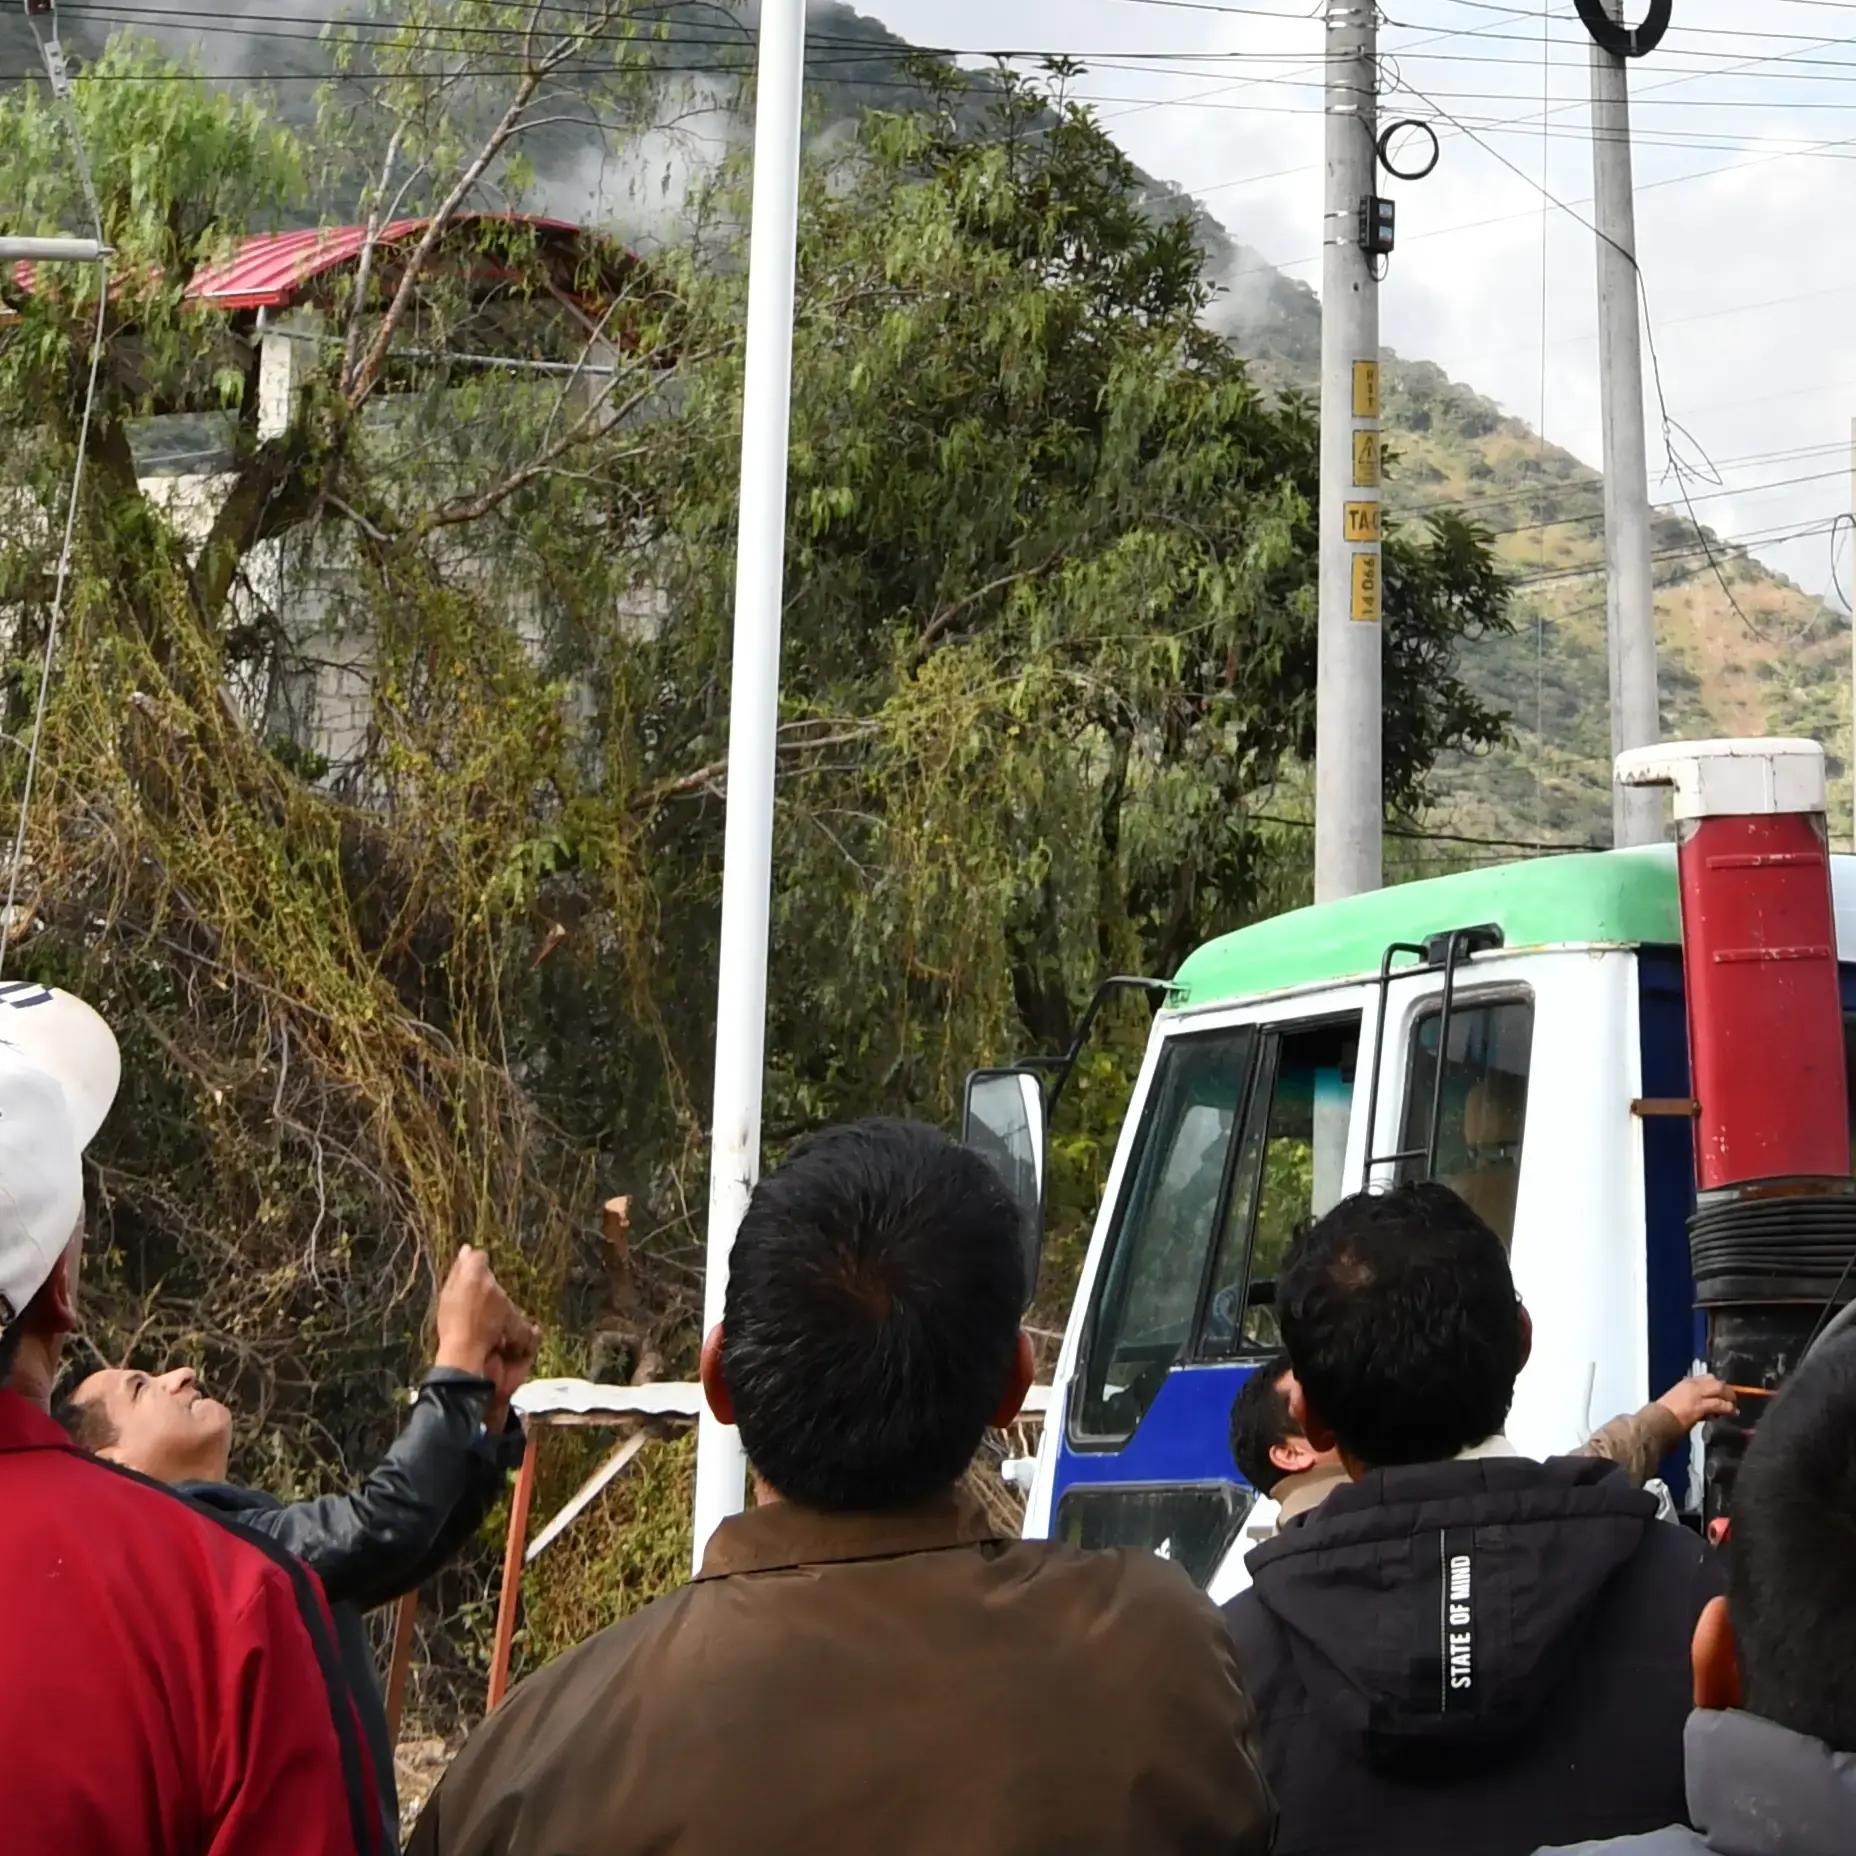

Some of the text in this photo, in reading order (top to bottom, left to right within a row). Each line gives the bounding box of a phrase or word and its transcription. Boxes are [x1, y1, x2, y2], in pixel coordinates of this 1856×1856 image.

[1450, 1555, 1471, 1688] STATE OF MIND
